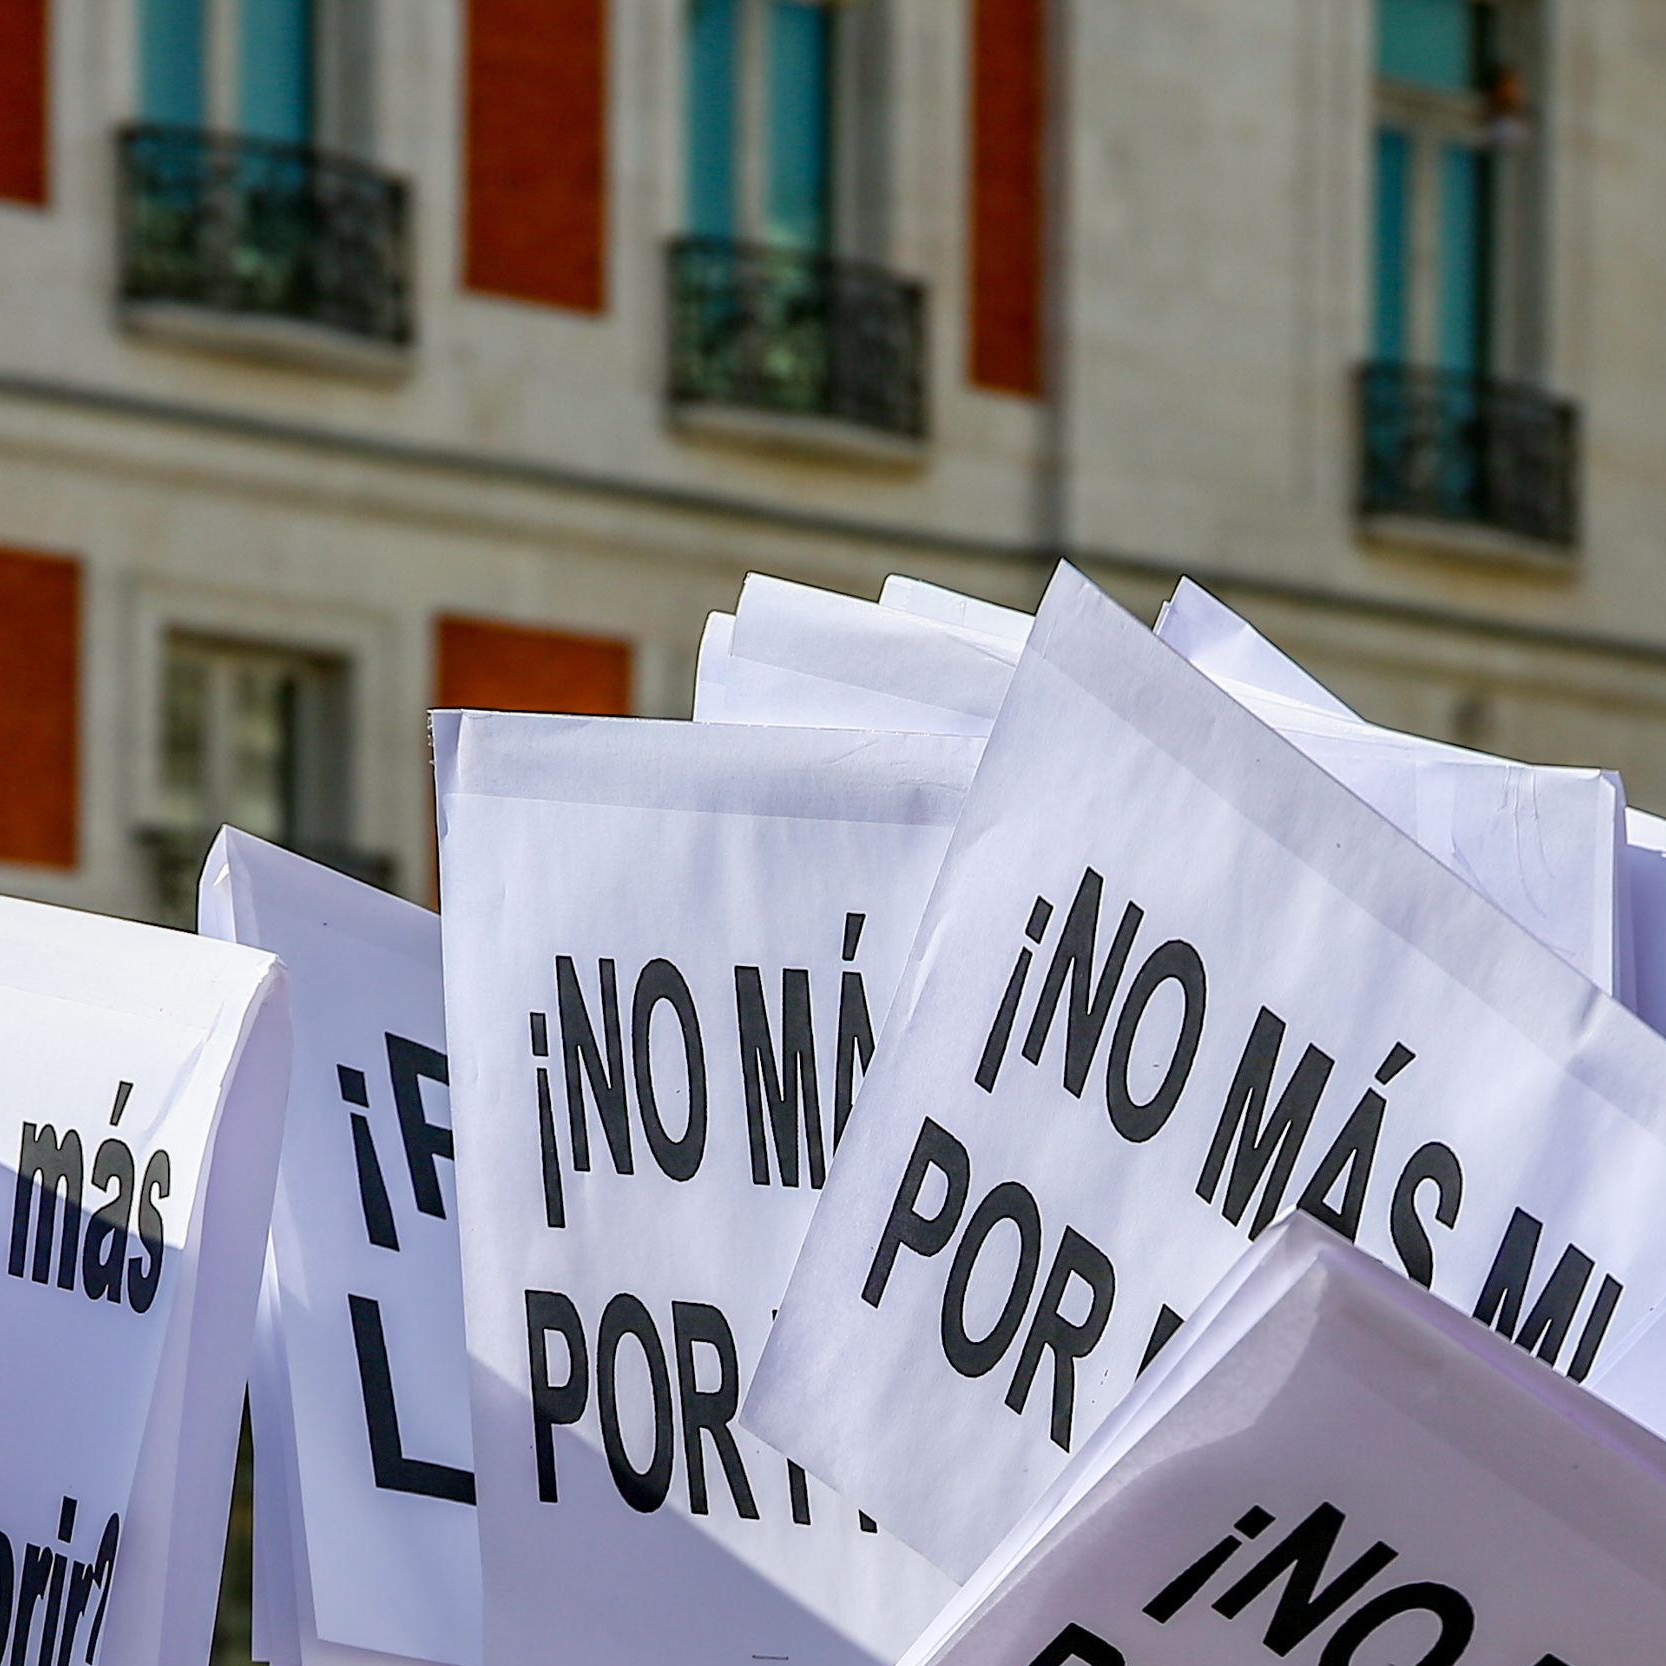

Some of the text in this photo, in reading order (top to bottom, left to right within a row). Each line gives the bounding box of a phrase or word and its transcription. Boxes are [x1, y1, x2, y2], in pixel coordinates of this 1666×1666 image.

[7, 1080, 173, 1315] más
[530, 911, 878, 1229] ¡NO MÁ
[974, 866, 1208, 1144] ¡NO
[1194, 1004, 1464, 1292] MÁS
[524, 1288, 760, 1520] POR
[861, 1115, 1116, 1454] POR
